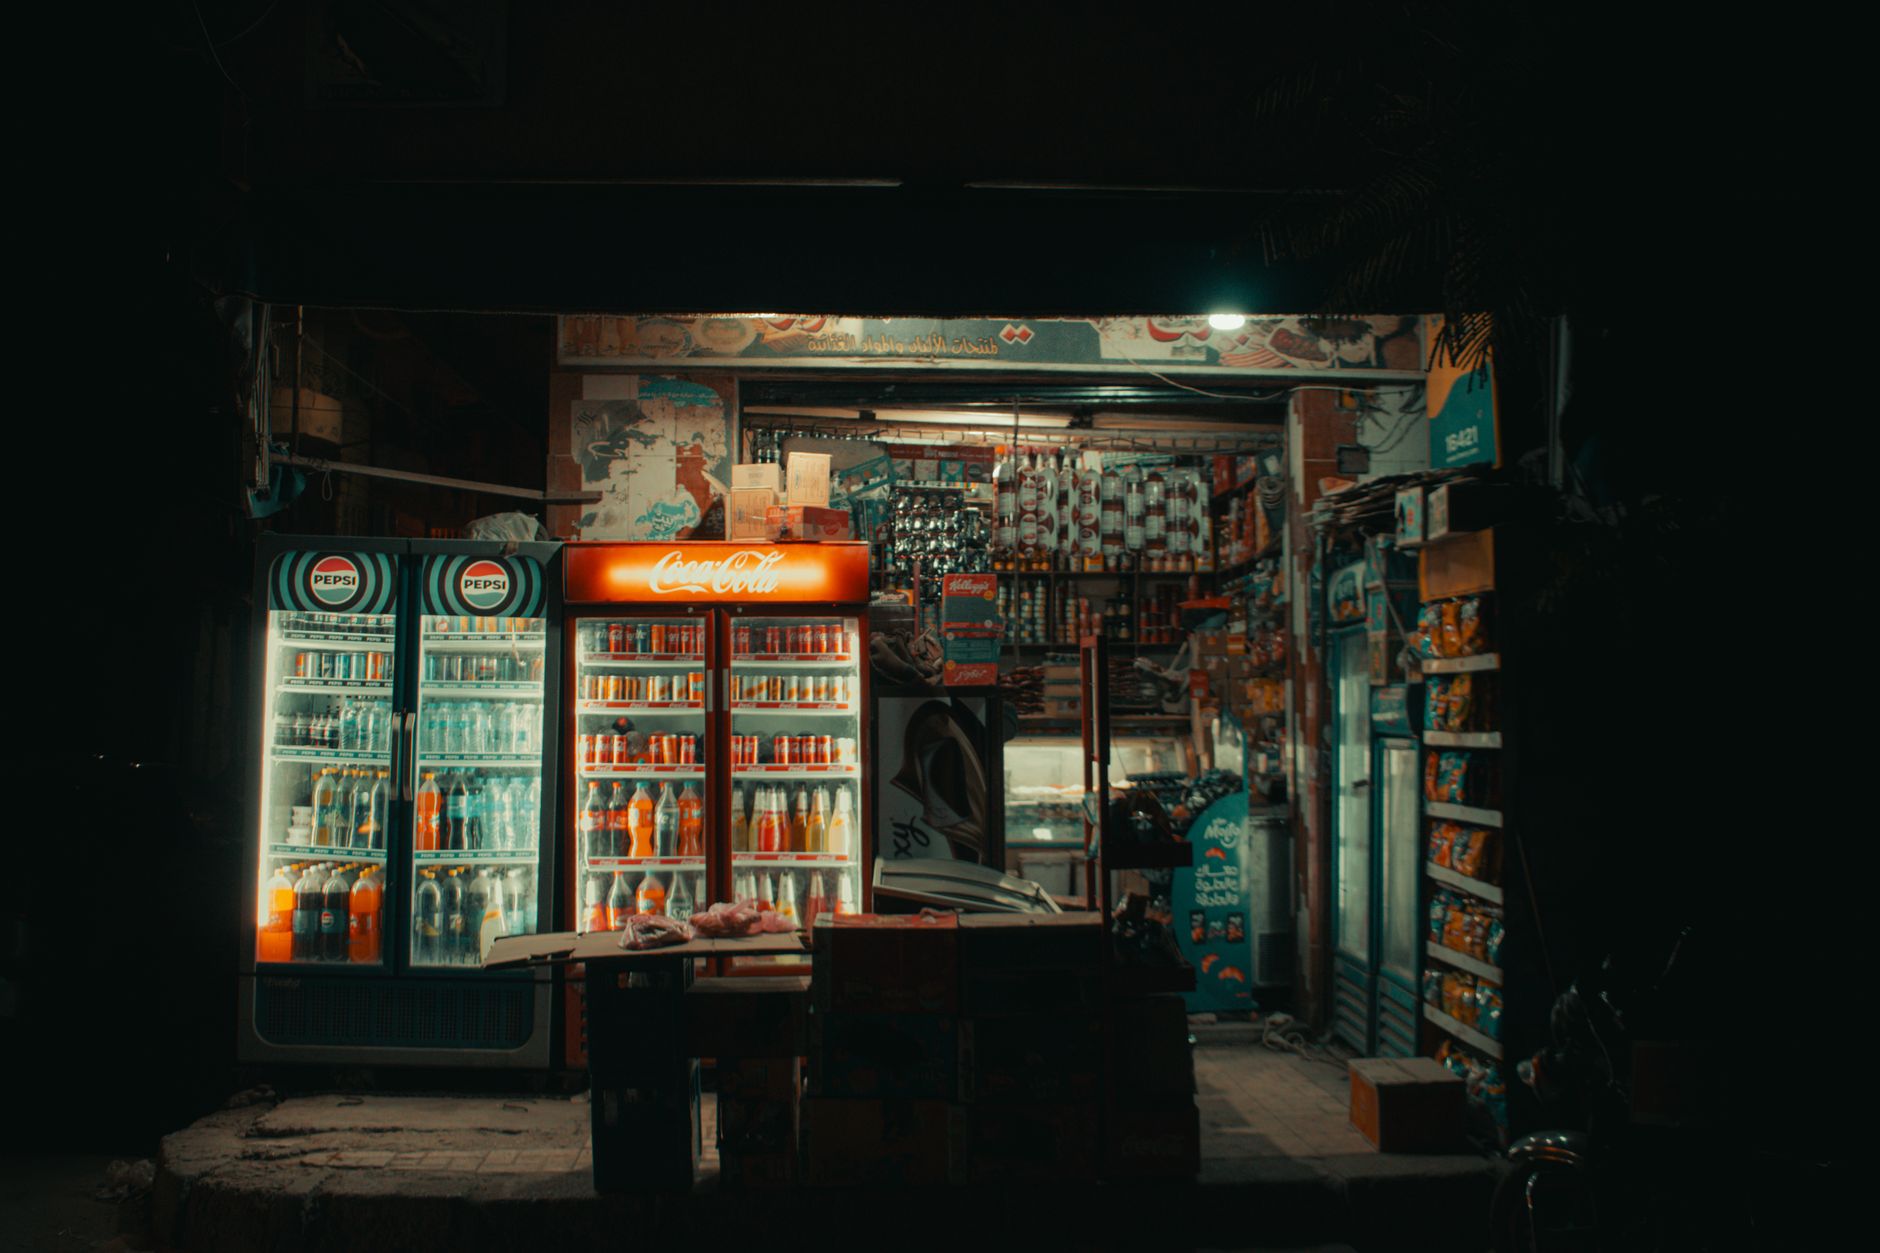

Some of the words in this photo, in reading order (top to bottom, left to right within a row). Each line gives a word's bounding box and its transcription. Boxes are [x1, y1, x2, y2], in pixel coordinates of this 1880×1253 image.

[648, 550, 787, 594] Coca-Cola
[314, 574, 356, 586] PEPSI
[464, 579, 506, 590] PEPSI
